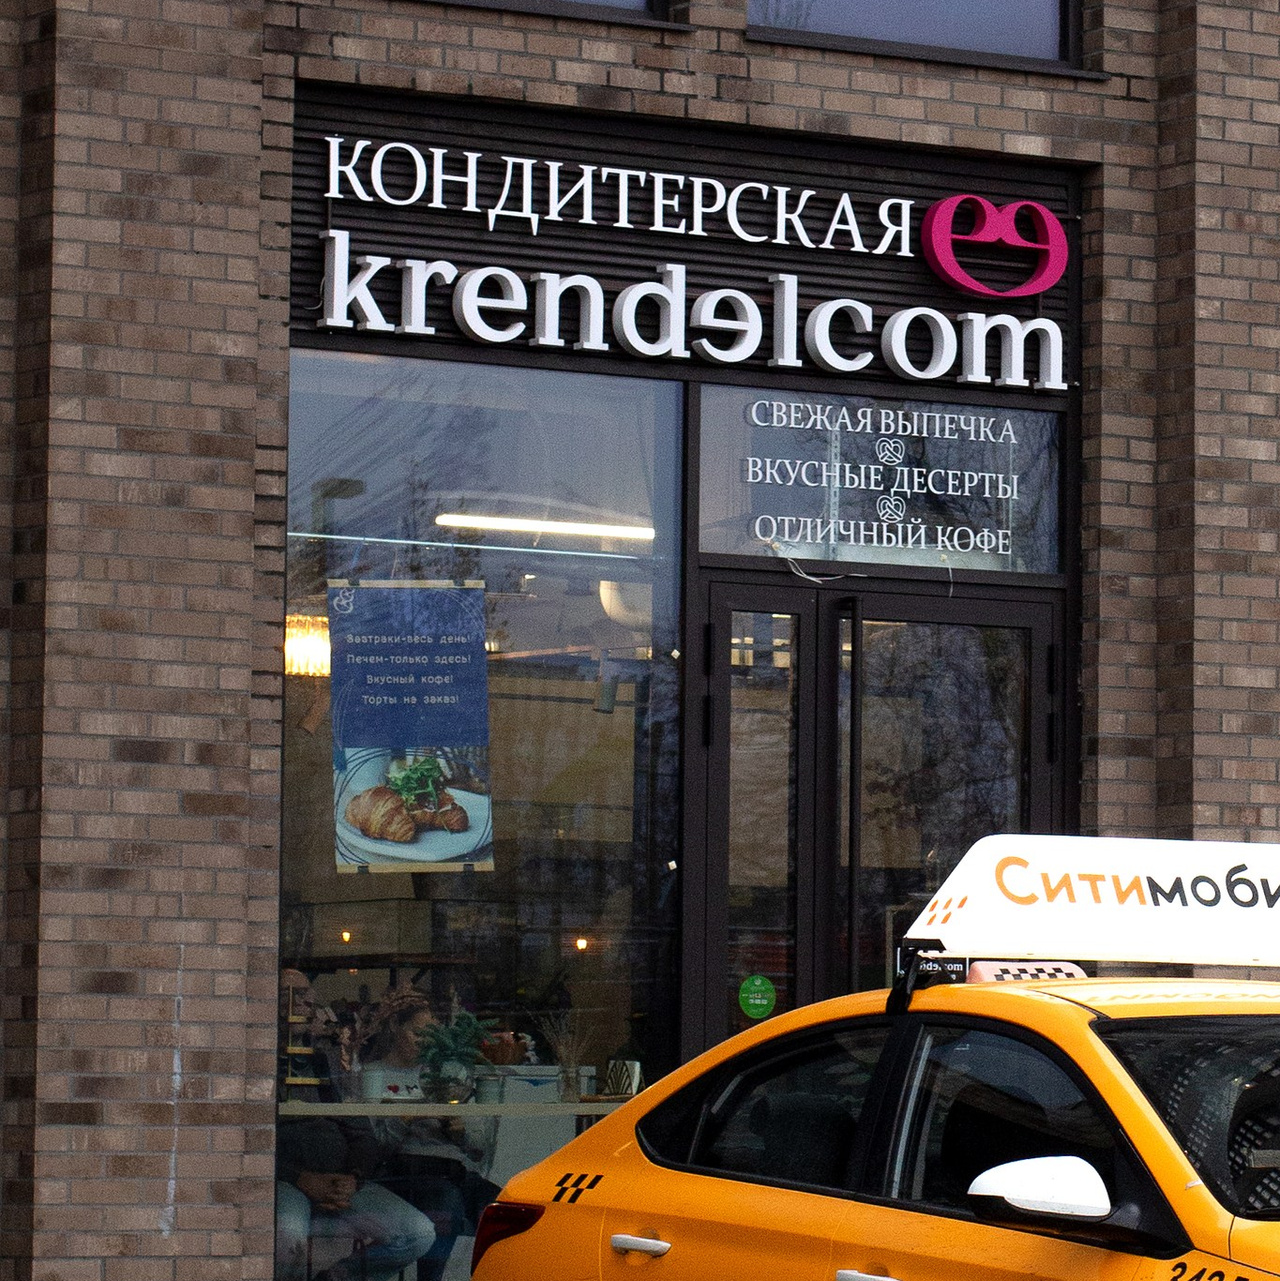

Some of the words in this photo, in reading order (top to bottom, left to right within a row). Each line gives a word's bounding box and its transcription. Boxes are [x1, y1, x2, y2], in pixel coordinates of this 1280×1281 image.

[324, 135, 915, 258] КОНДИТЕРСКАЯ
[750, 400, 873, 433] СВЕЖАЯ
[879, 409, 1018, 444] ВЫПЕЧКА
[746, 456, 884, 491] ВКУСНЫЕ
[890, 467, 1020, 499] ДЕСЕРТЫ
[754, 515, 927, 549] ОТЛИЧНЫЙ
[935, 525, 1012, 555] КОФЕ
[362, 695, 397, 705] Торты
[403, 696, 417, 704] на
[423, 695, 459, 704] заказ!
[366, 674, 415, 685] Вкусный
[421, 675, 453, 686] кофе!
